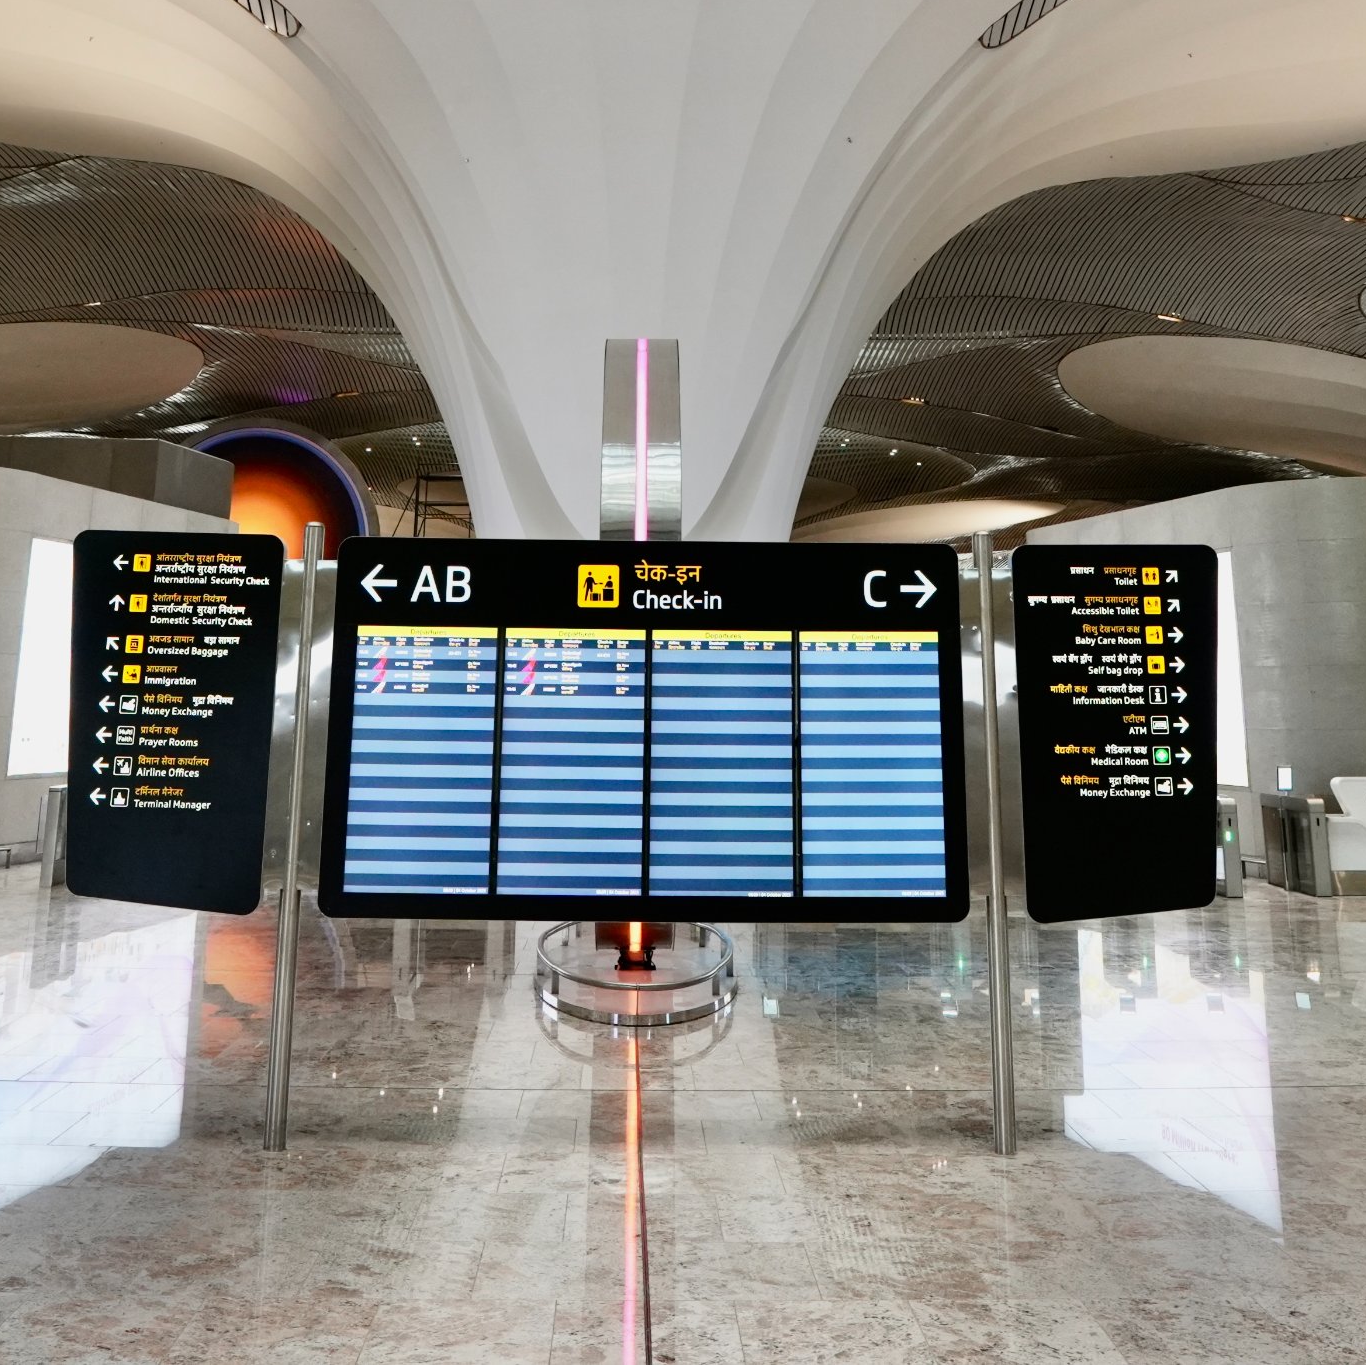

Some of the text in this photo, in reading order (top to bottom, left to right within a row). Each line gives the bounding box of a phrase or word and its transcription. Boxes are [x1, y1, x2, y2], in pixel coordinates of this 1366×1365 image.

[197, 554, 215, 564] सुरक्षा
[197, 565, 217, 575] सुरक्षा
[634, 559, 702, 585] चेक-इन
[153, 575, 270, 586] International Security Check
[411, 566, 471, 603] AB
[1114, 578, 1137, 586] Toilet
[863, 569, 887, 608] C
[183, 594, 201, 604] सुरक्षा
[633, 589, 722, 610] Check-in
[1071, 606, 1139, 615] Accessible Toilet
[150, 616, 253, 627] Domestic Security Check
[1075, 636, 1141, 646] Baby Care Room
[147, 646, 229, 657] Oversized Baggage
[1088, 666, 1143, 676] Self bag drop
[145, 676, 197, 686] Immigration
[1073, 696, 1145, 704] Information Desk
[142, 707, 213, 718] Money Exchange
[1129, 726, 1147, 734] ATM
[139, 738, 198, 748] Prayer Rooms
[138, 754, 159, 765] विमान
[161, 756, 175, 765] सेवा
[1091, 757, 1149, 766] Medical Room
[136, 768, 199, 777] Airline Offices
[1080, 788, 1151, 798] Money Exchange
[133, 800, 211, 811] Terminal Manager
